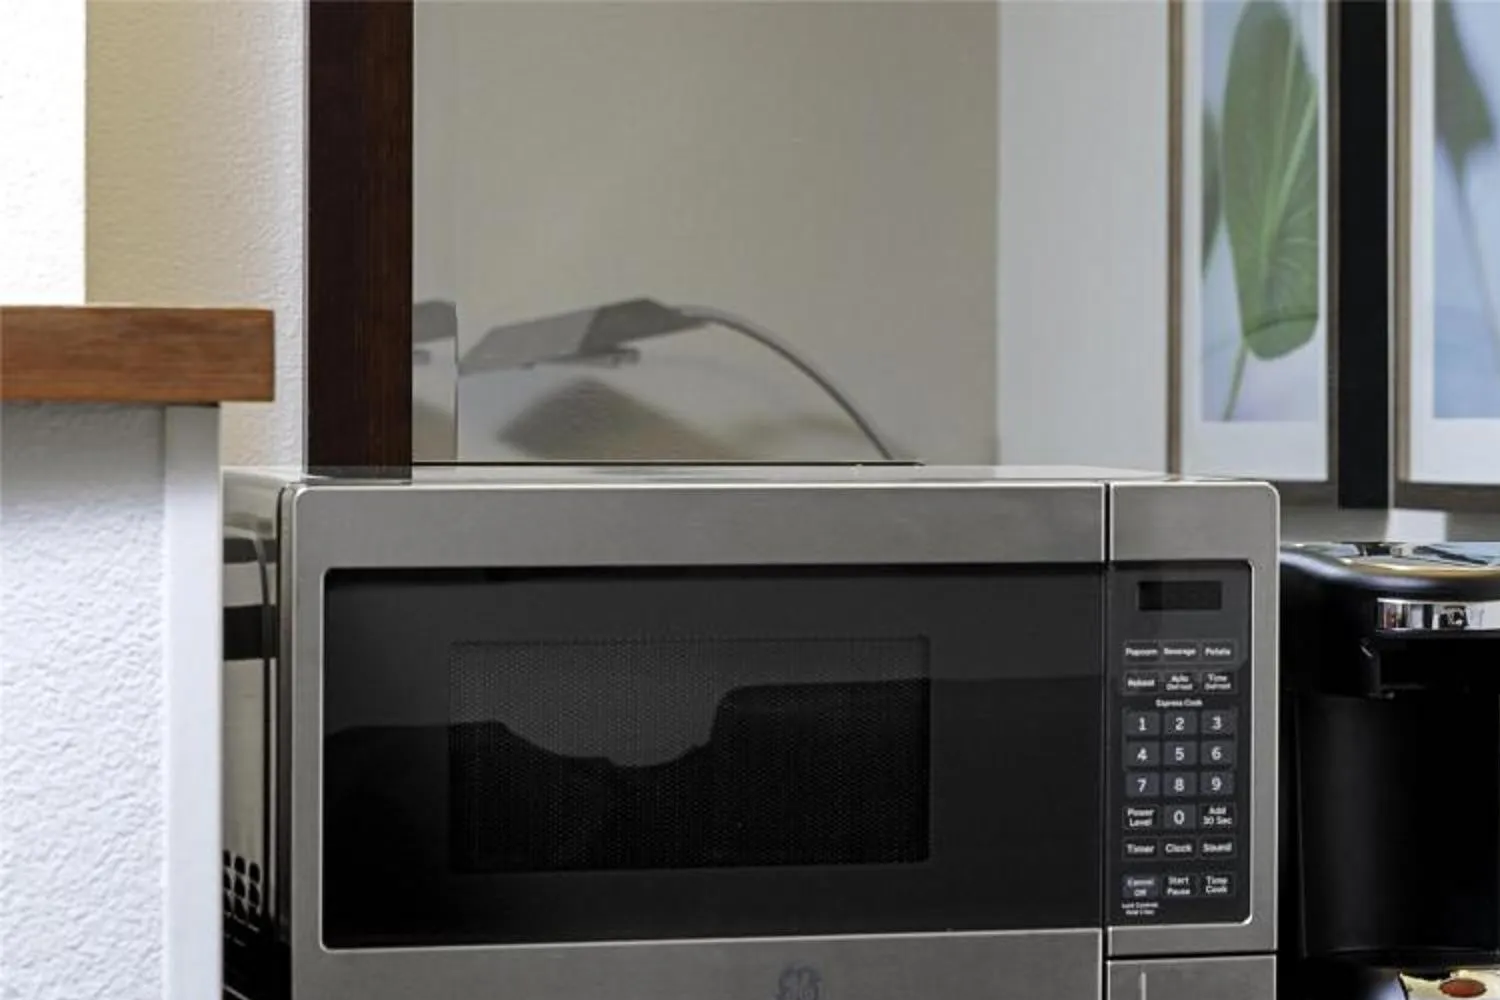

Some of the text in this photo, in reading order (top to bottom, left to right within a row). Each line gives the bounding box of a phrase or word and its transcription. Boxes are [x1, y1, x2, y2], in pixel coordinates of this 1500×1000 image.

[1139, 716, 1147, 732] 1
[1175, 716, 1185, 731] 2
[1211, 715, 1222, 731] 3
[1136, 747, 1148, 762] 4
[1175, 746, 1185, 761] 5
[1211, 746, 1222, 761] 6
[1137, 777, 1147, 793] 7
[1174, 777, 1185, 793] 8
[1211, 776, 1222, 792] 9
[1127, 807, 1154, 817] Power
[1173, 809, 1185, 825] 0
[1129, 817, 1152, 827] Level
[1127, 843, 1155, 854] Timer
[1165, 843, 1192, 853] Clock
[1203, 842, 1232, 853] Sound
[1206, 875, 1228, 885] Time
[1205, 885, 1228, 894] Cook
